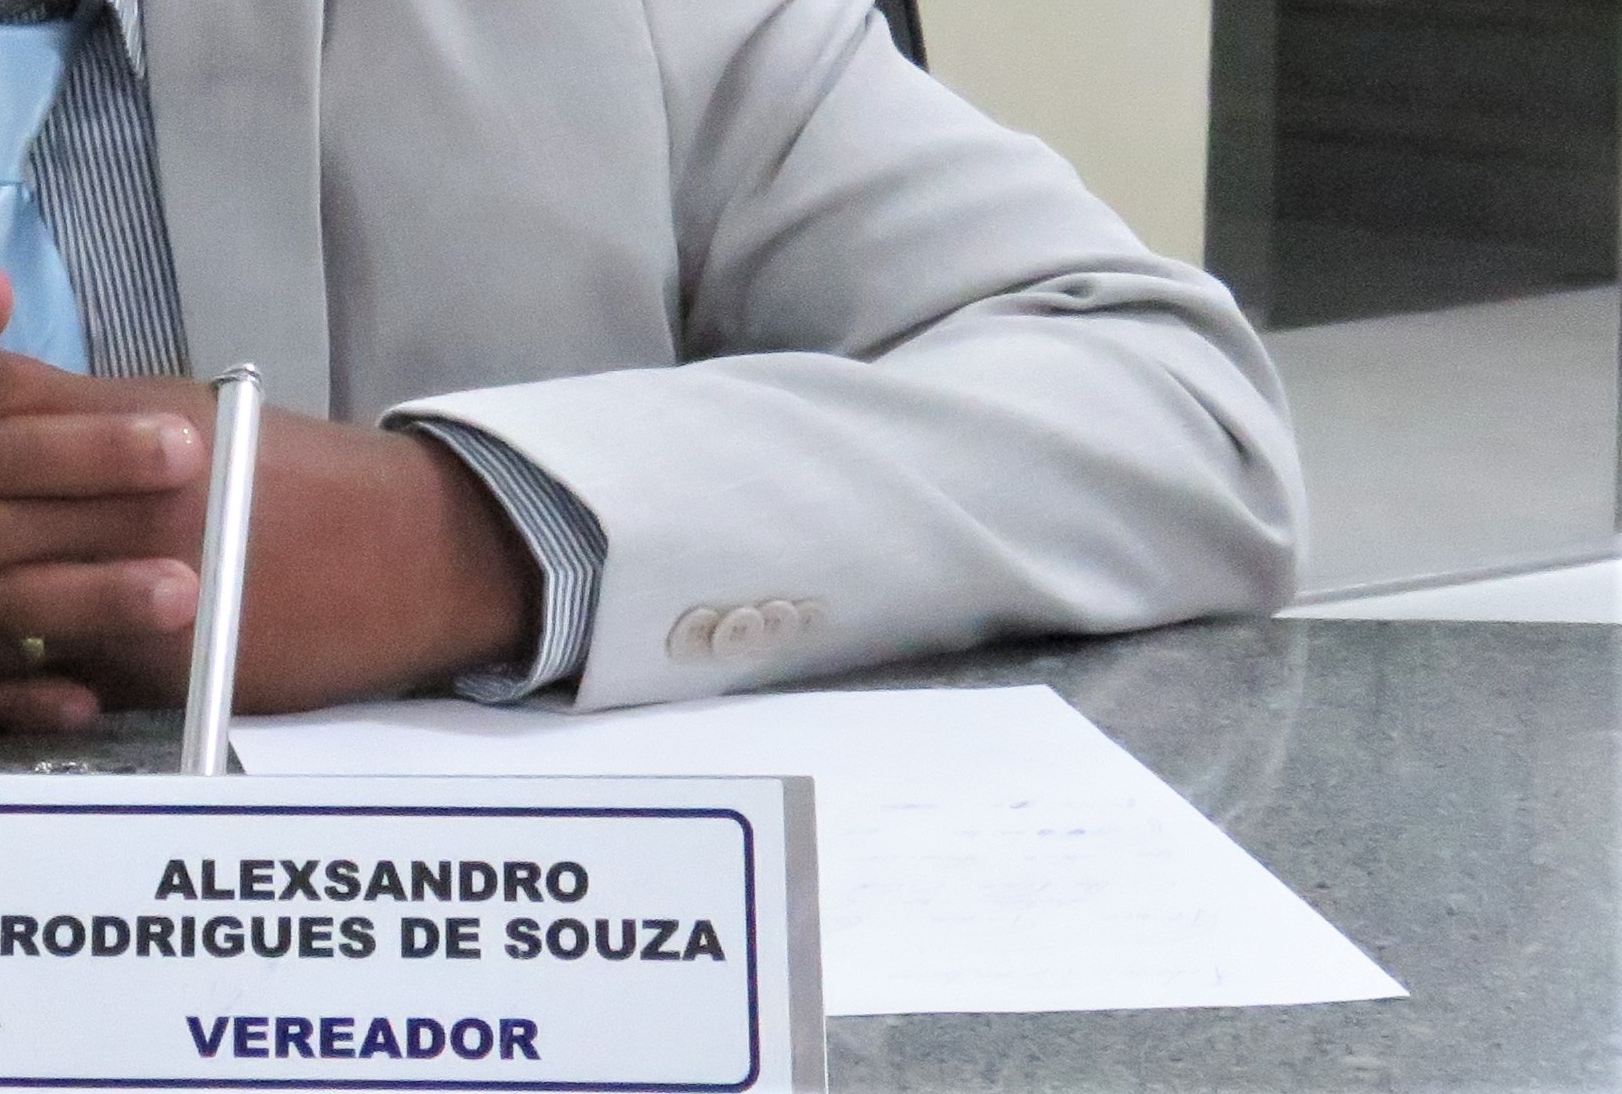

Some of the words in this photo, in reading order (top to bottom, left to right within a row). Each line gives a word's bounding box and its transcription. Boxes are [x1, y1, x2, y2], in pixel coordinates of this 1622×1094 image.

[154, 858, 590, 904] ALEXSANDRO
[0, 914, 377, 960] RODRIGUES
[399, 917, 482, 960] DE
[504, 917, 726, 962] SOUZA
[185, 1015, 541, 1061] VEREADOR
